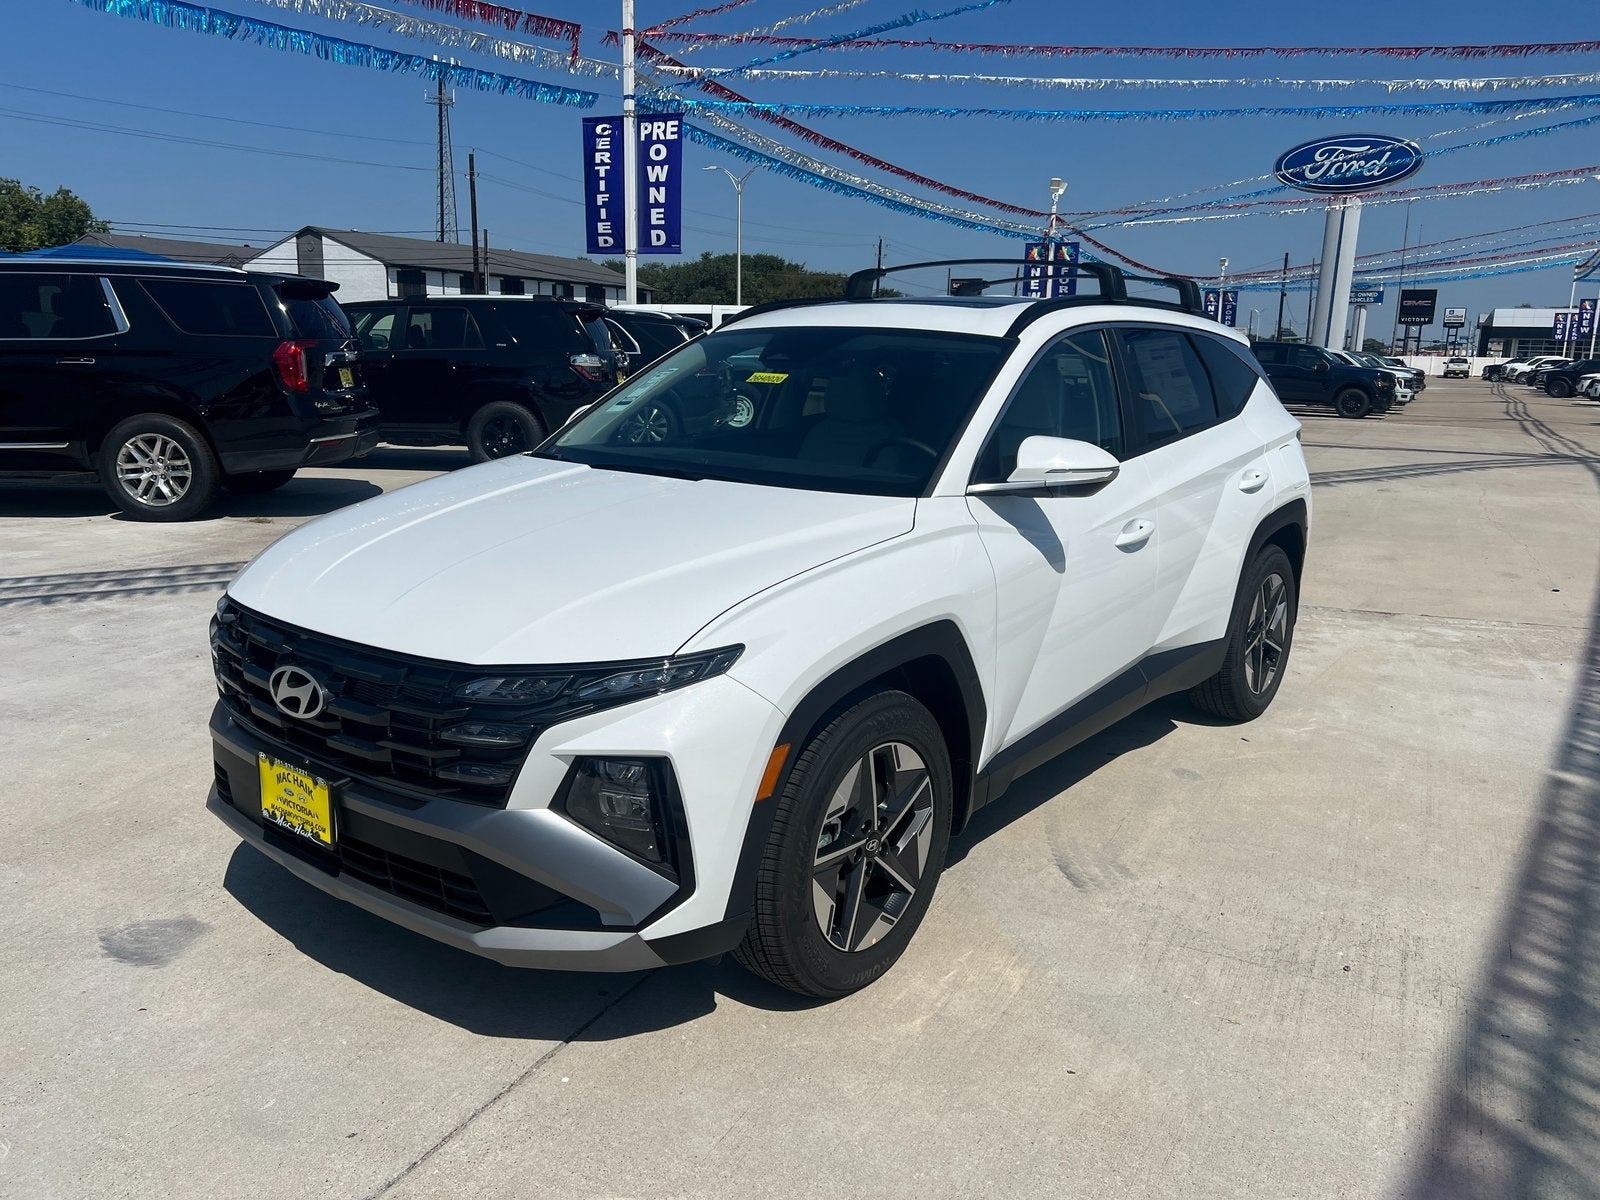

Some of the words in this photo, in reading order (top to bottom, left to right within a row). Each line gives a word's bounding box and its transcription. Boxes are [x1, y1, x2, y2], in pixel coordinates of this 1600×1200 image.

[640, 120, 679, 141] PRE
[1304, 145, 1392, 179] Ford
[594, 123, 614, 247] CERTIFIED
[646, 143, 668, 246] OWNED
[1058, 267, 1069, 297] FOR
[1554, 323, 1563, 339] NEW
[1580, 313, 1590, 333] NEW
[276, 771, 292, 785] MAC
[292, 774, 314, 800] HAIK
[275, 815, 293, 829] Mac
